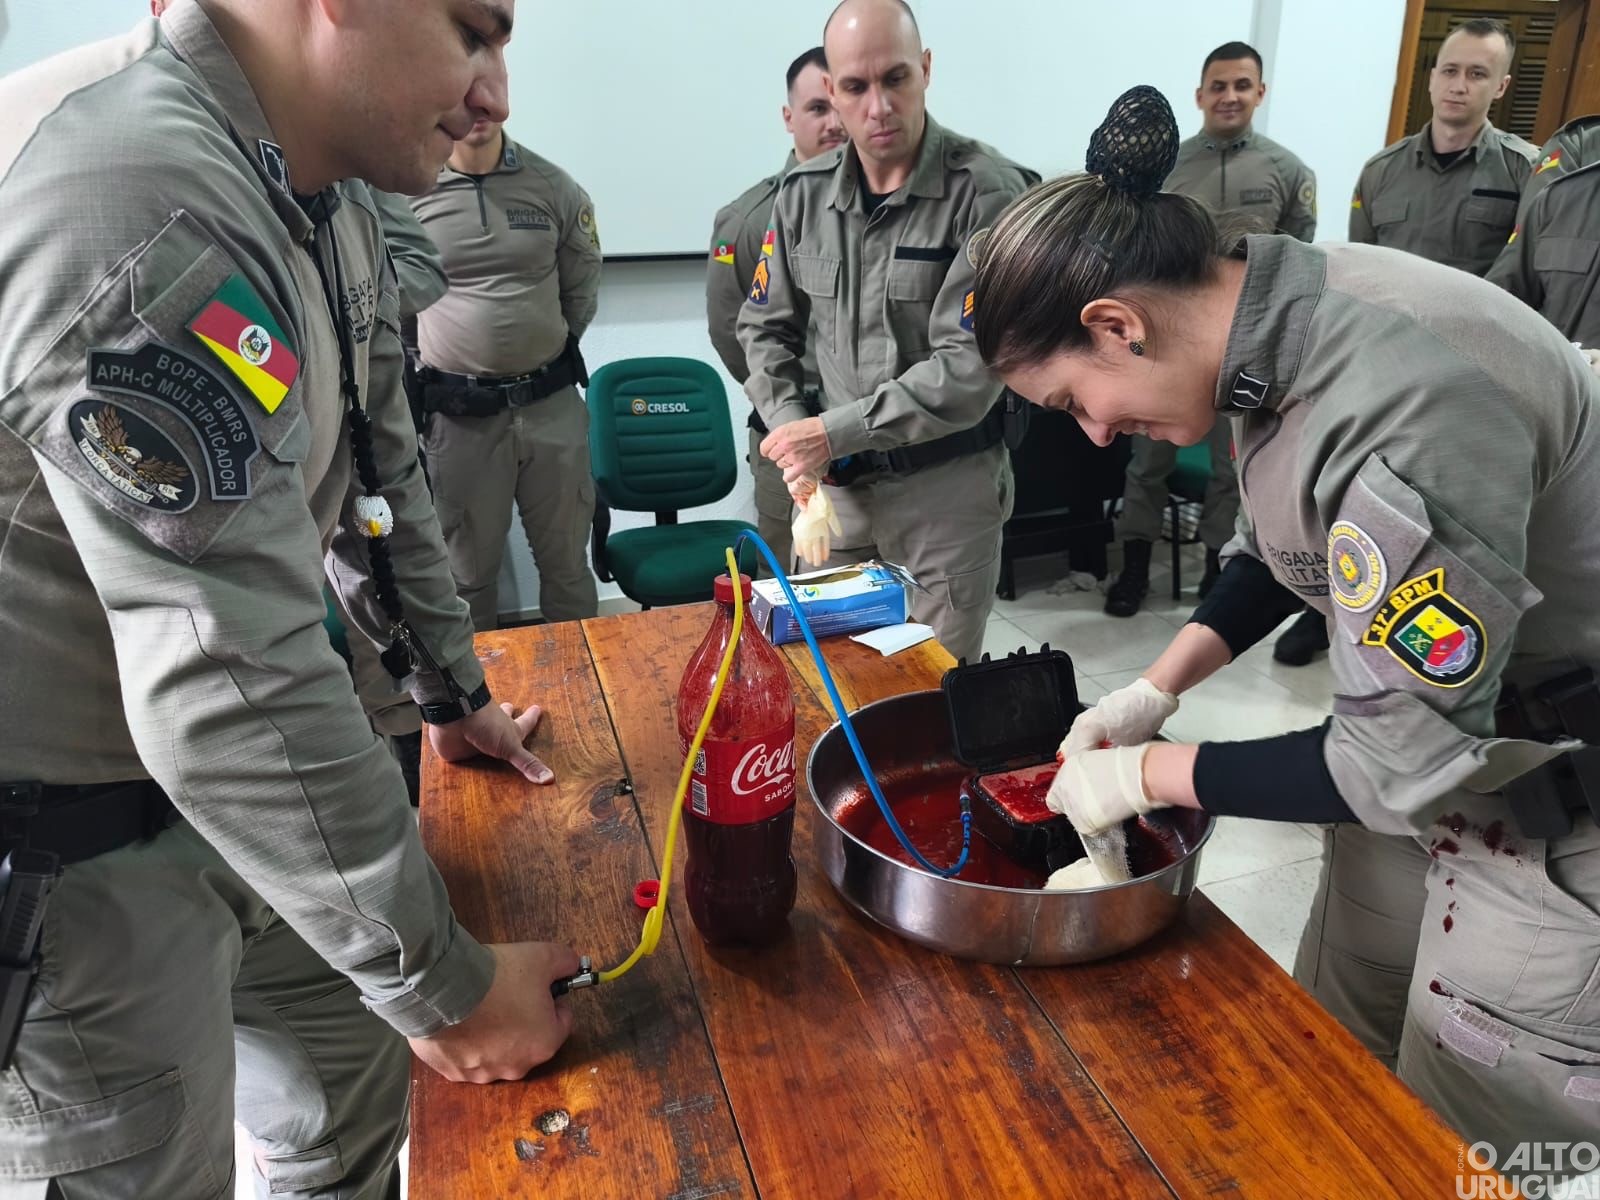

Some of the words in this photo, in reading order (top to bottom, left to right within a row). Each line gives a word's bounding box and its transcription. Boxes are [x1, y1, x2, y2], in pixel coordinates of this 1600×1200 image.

[156, 354, 209, 391] BOPE
[213, 396, 247, 443] BMRS
[647, 402, 690, 414] CRESOL
[96, 363, 154, 388] APH-C
[157, 377, 236, 491] MULTIPLICADOR
[1388, 579, 1434, 611] BPM
[731, 737, 796, 795] Coca
[764, 782, 792, 802] SABOR
